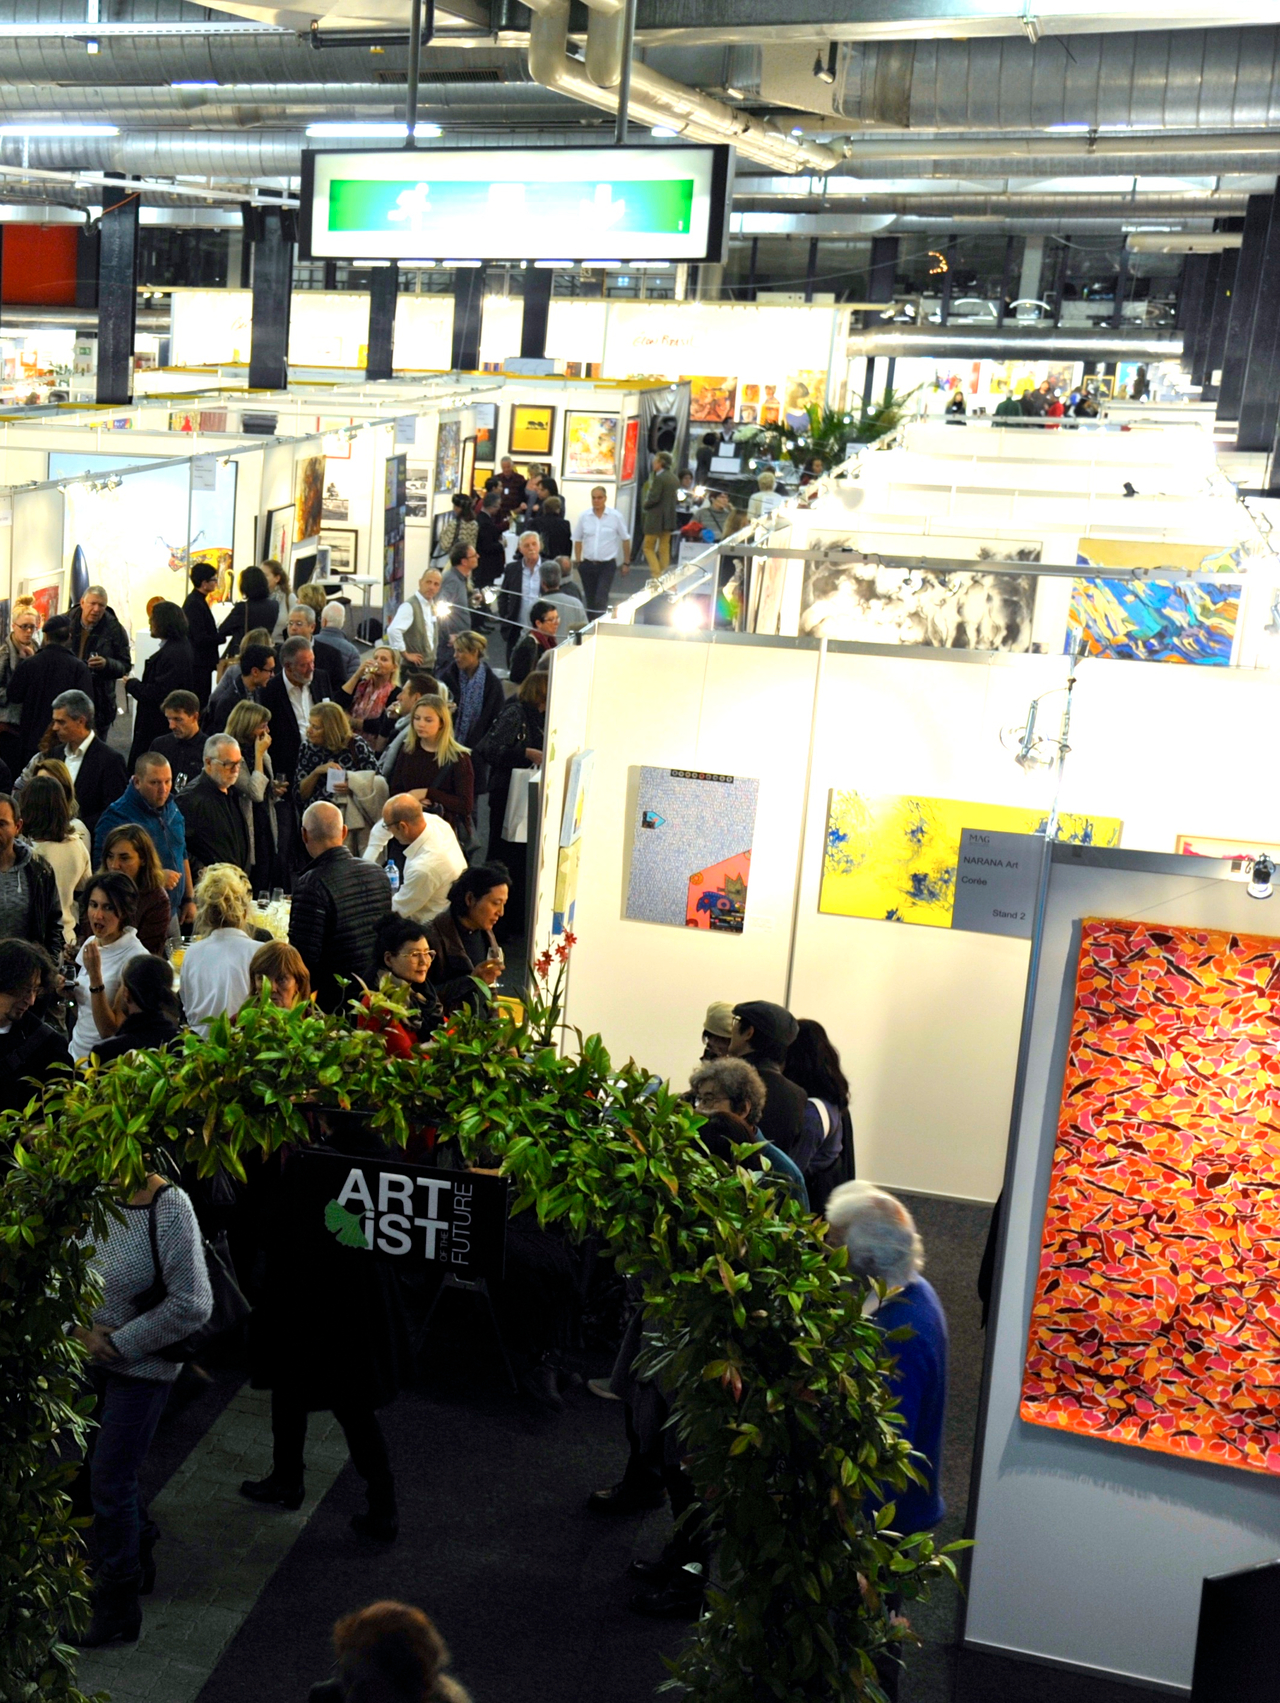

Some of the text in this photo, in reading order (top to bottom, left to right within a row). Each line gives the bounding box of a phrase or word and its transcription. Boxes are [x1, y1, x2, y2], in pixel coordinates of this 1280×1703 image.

[969, 834, 990, 844] MAG
[963, 856, 1019, 869] NARANA Art
[961, 875, 988, 886] Corée
[992, 909, 1026, 920] Stand 2
[336, 1168, 452, 1220] ART
[451, 1181, 473, 1265] FUTURE
[439, 1231, 449, 1262] OF THE
